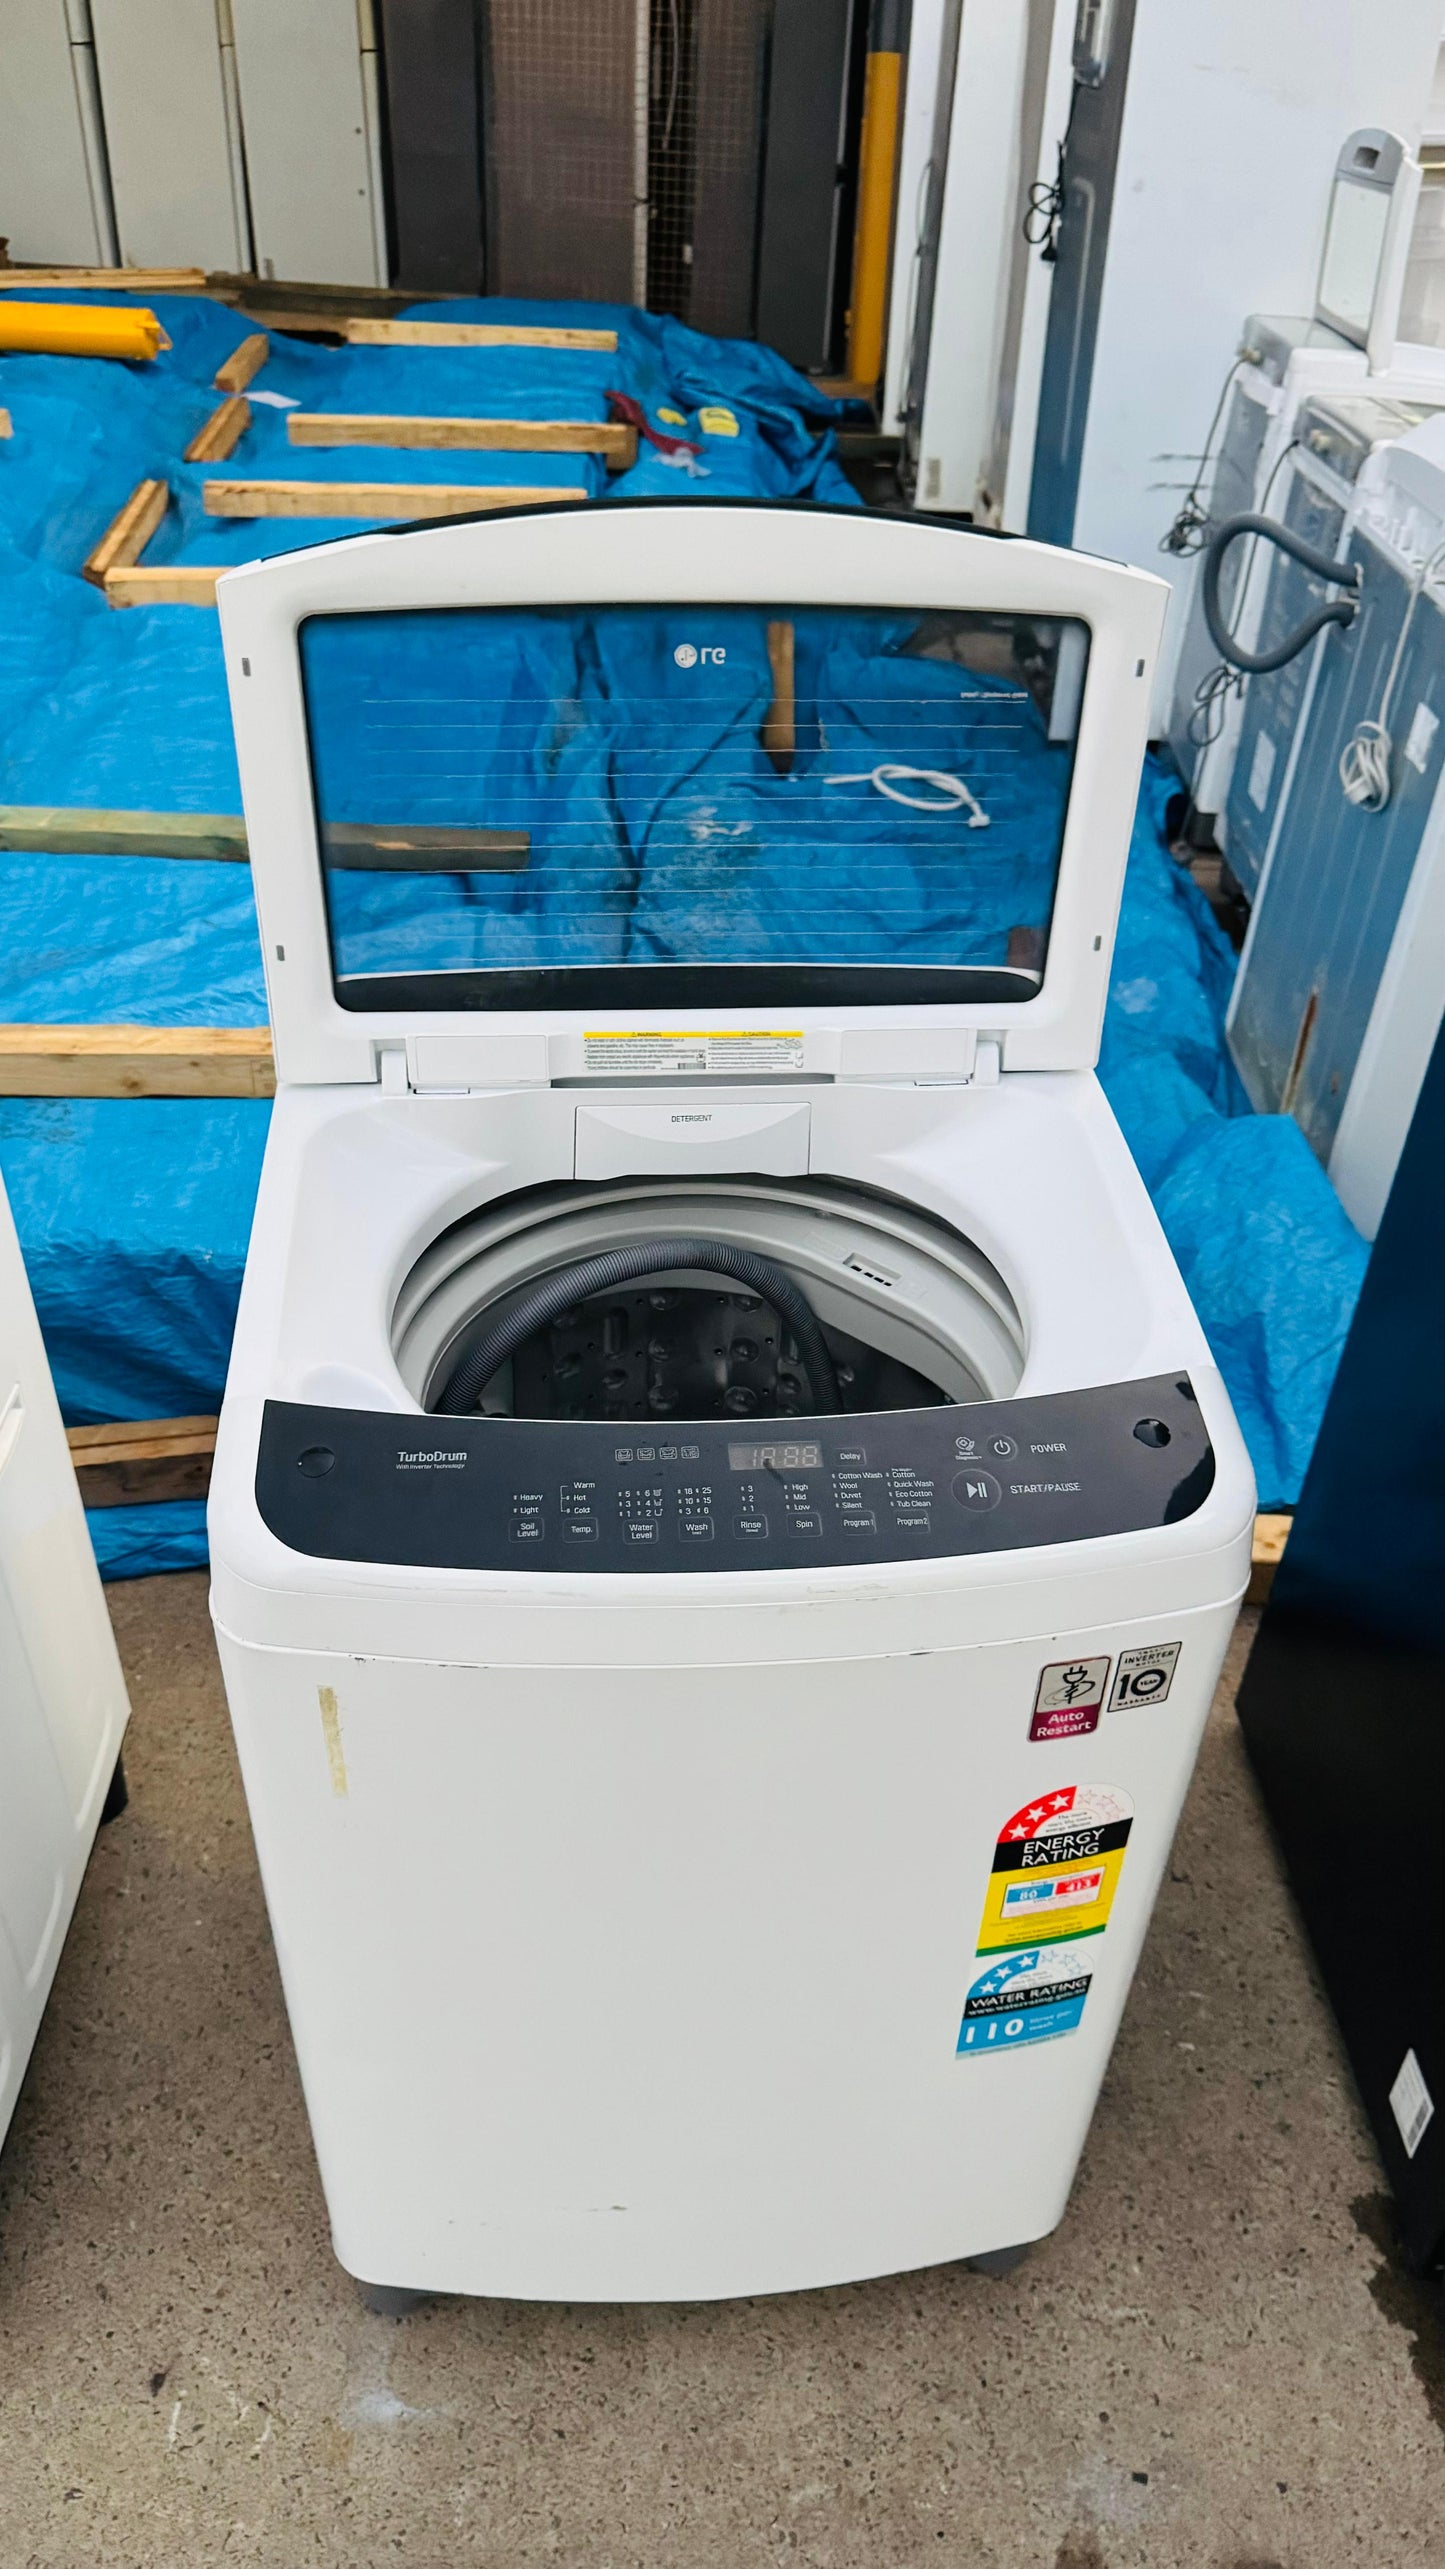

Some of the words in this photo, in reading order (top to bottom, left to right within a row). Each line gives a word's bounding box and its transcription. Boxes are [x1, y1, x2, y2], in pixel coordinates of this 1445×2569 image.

[671, 1114, 712, 1122] DETERGENT
[1030, 1443, 1067, 1453] POWER
[397, 1451, 467, 1462] TurboDrum
[838, 1472, 861, 1480] Cotton
[1010, 1482, 1082, 1494] START/PAUSE
[625, 1490, 631, 1498] 5
[520, 1507, 539, 1515] Light
[520, 1522, 535, 1530] Soil
[685, 1523, 708, 1531] Wash
[740, 1521, 762, 1529] Rinse
[795, 1520, 813, 1529] Spin
[843, 1519, 870, 1528] Program
[571, 1525, 593, 1534] Temp.
[631, 1531, 652, 1539] Level
[1124, 1650, 1174, 1664] INVERTER
[1118, 1669, 1167, 1700] 10
[1048, 1711, 1084, 1724] Auto
[1037, 1720, 1092, 1737] Restart
[1023, 1828, 1105, 1854] ENERGY
[1021, 1842, 1099, 1867] RATING
[971, 1992, 1025, 2008] WATER
[1030, 1978, 1088, 1998] RATING
[965, 2018, 1024, 2044] 110
